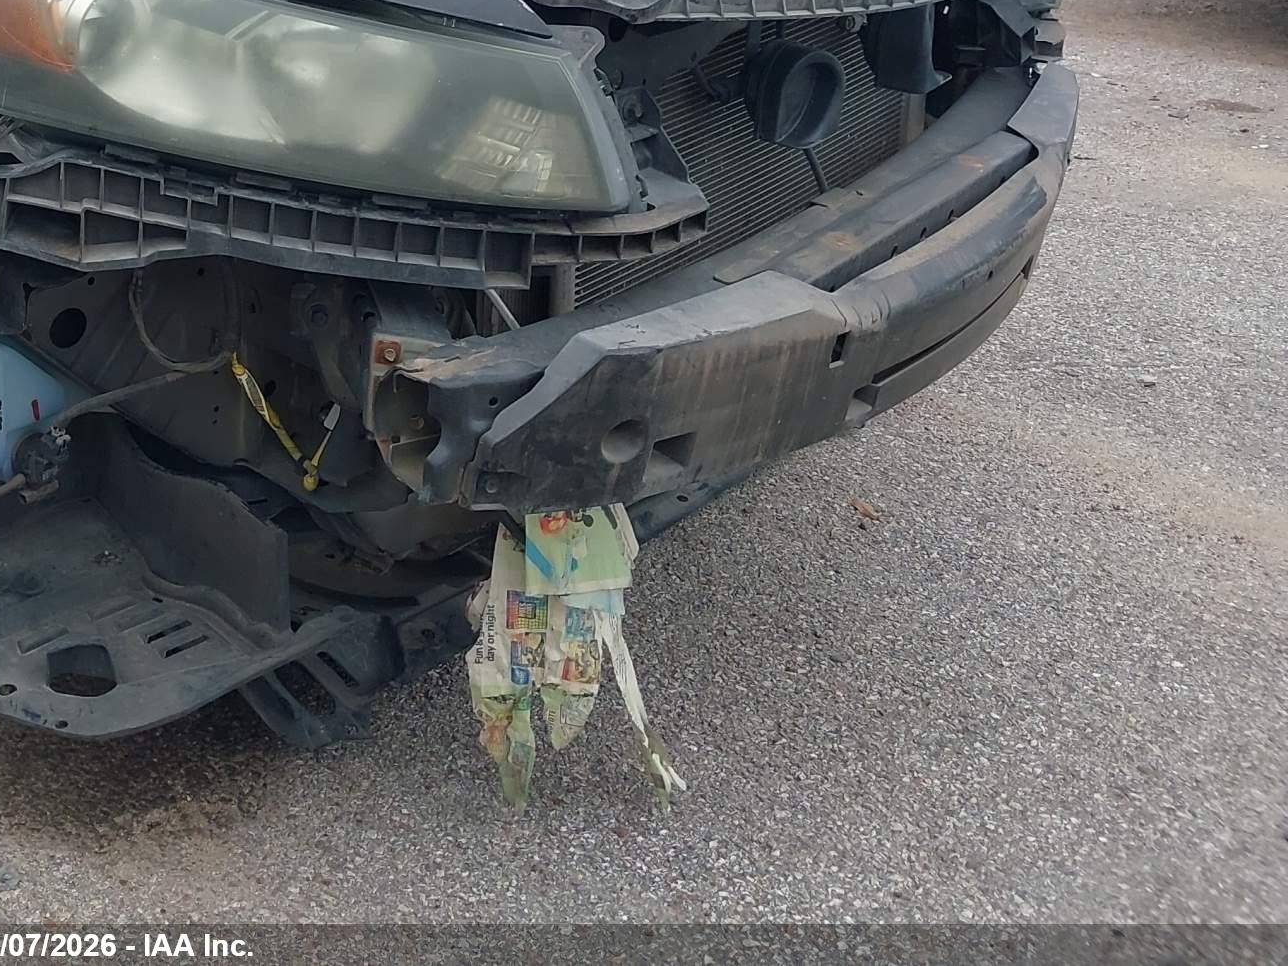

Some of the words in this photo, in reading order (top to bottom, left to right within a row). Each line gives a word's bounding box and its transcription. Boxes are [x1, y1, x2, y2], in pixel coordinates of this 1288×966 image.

[486, 604, 496, 632] night
[487, 633, 495, 644] or
[475, 646, 483, 664] Fun
[486, 646, 496, 662] day
